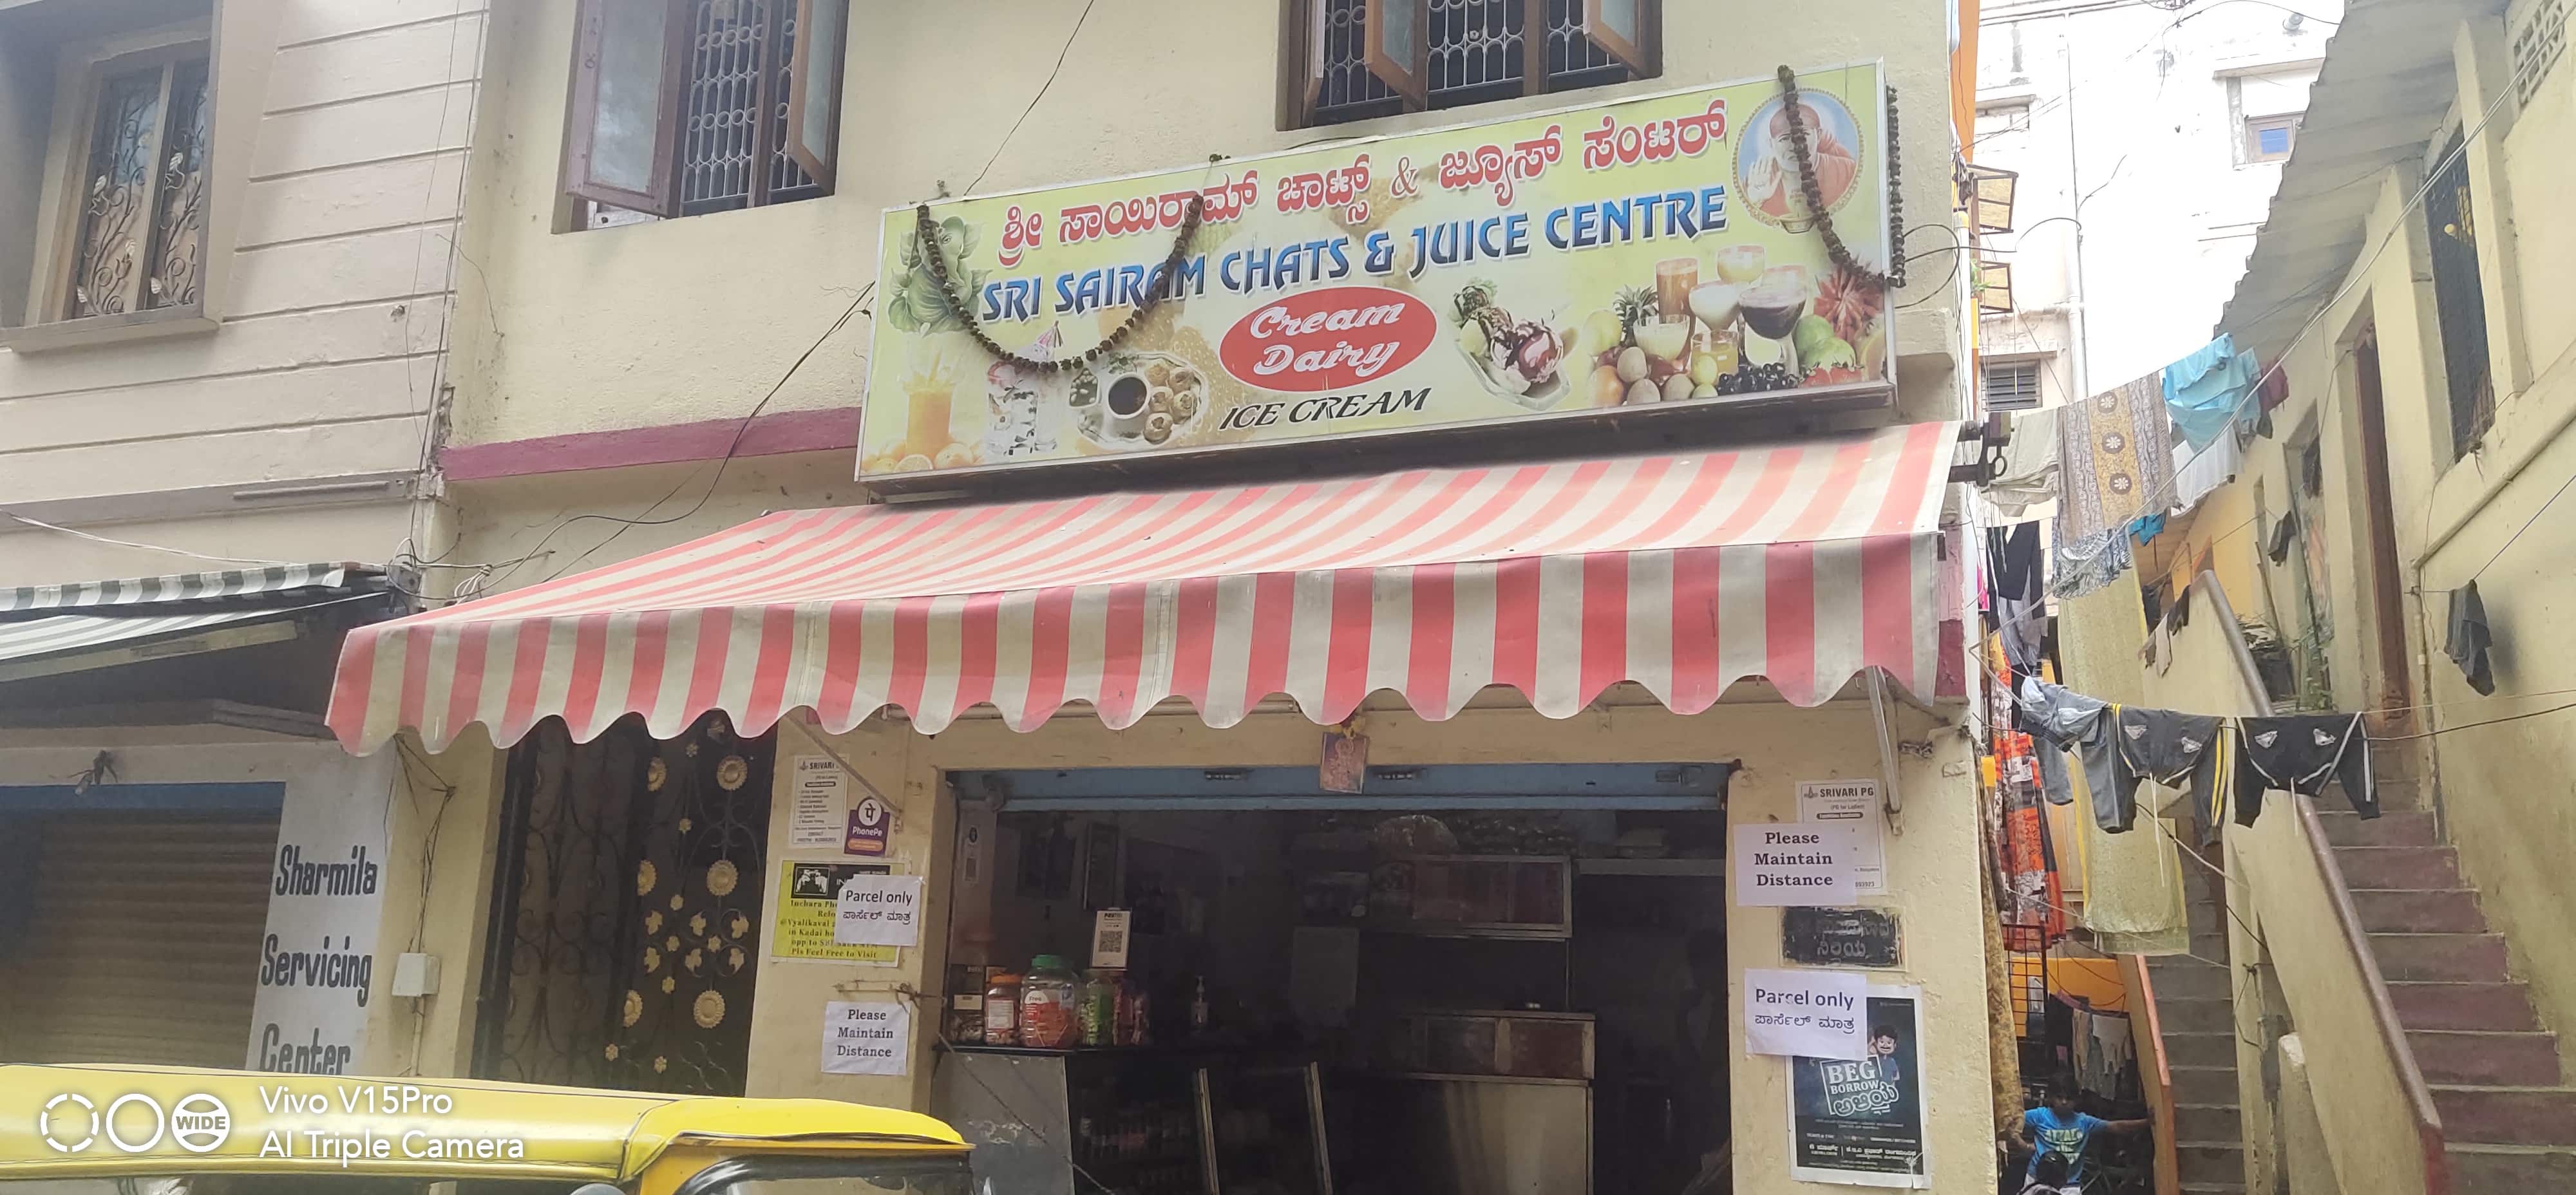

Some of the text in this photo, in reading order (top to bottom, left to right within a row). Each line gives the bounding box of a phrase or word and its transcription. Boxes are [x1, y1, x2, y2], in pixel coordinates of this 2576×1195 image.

[999, 100, 1727, 266] ಶ್ರೀ ಸಾಯಿರಾಮ್ ಚಾಟ್ಸ್ & ಜ್ಯೂಸ್ ಸೆಂಟರ್
[983, 185, 1727, 321] SRI SAIRAM CHATS & JUICE CENTRE
[1250, 303, 1406, 339] Cream
[1253, 341, 1401, 377] Dairy
[1218, 387, 1432, 431] ICE CREAM
[1820, 787, 1857, 798] SRIVARI
[1861, 787, 1874, 796] PG
[852, 826, 883, 836] PhonePe
[1765, 832, 1819, 845] Please
[1754, 852, 1833, 865] Maintain
[275, 845, 377, 896] Sharmila
[1756, 874, 1833, 887] Distance
[846, 890, 913, 907] Parcel only
[843, 909, 911, 925] ಪಾರ್ಸೆಲ್ ಮಾತ್ರ
[261, 934, 372, 1008] Servicing
[1756, 988, 1854, 1011] Parcel only
[848, 1009, 887, 1021] Please
[1755, 1013, 1855, 1034] ಪಾರ್ಸೆಲ್ ಮಾತ್ರ
[838, 1027, 894, 1039] Maintain
[260, 1022, 351, 1076] Center
[837, 1045, 893, 1058] Distance
[1826, 1060, 1877, 1084] BEG
[1830, 1079, 1879, 1095] BORROW
